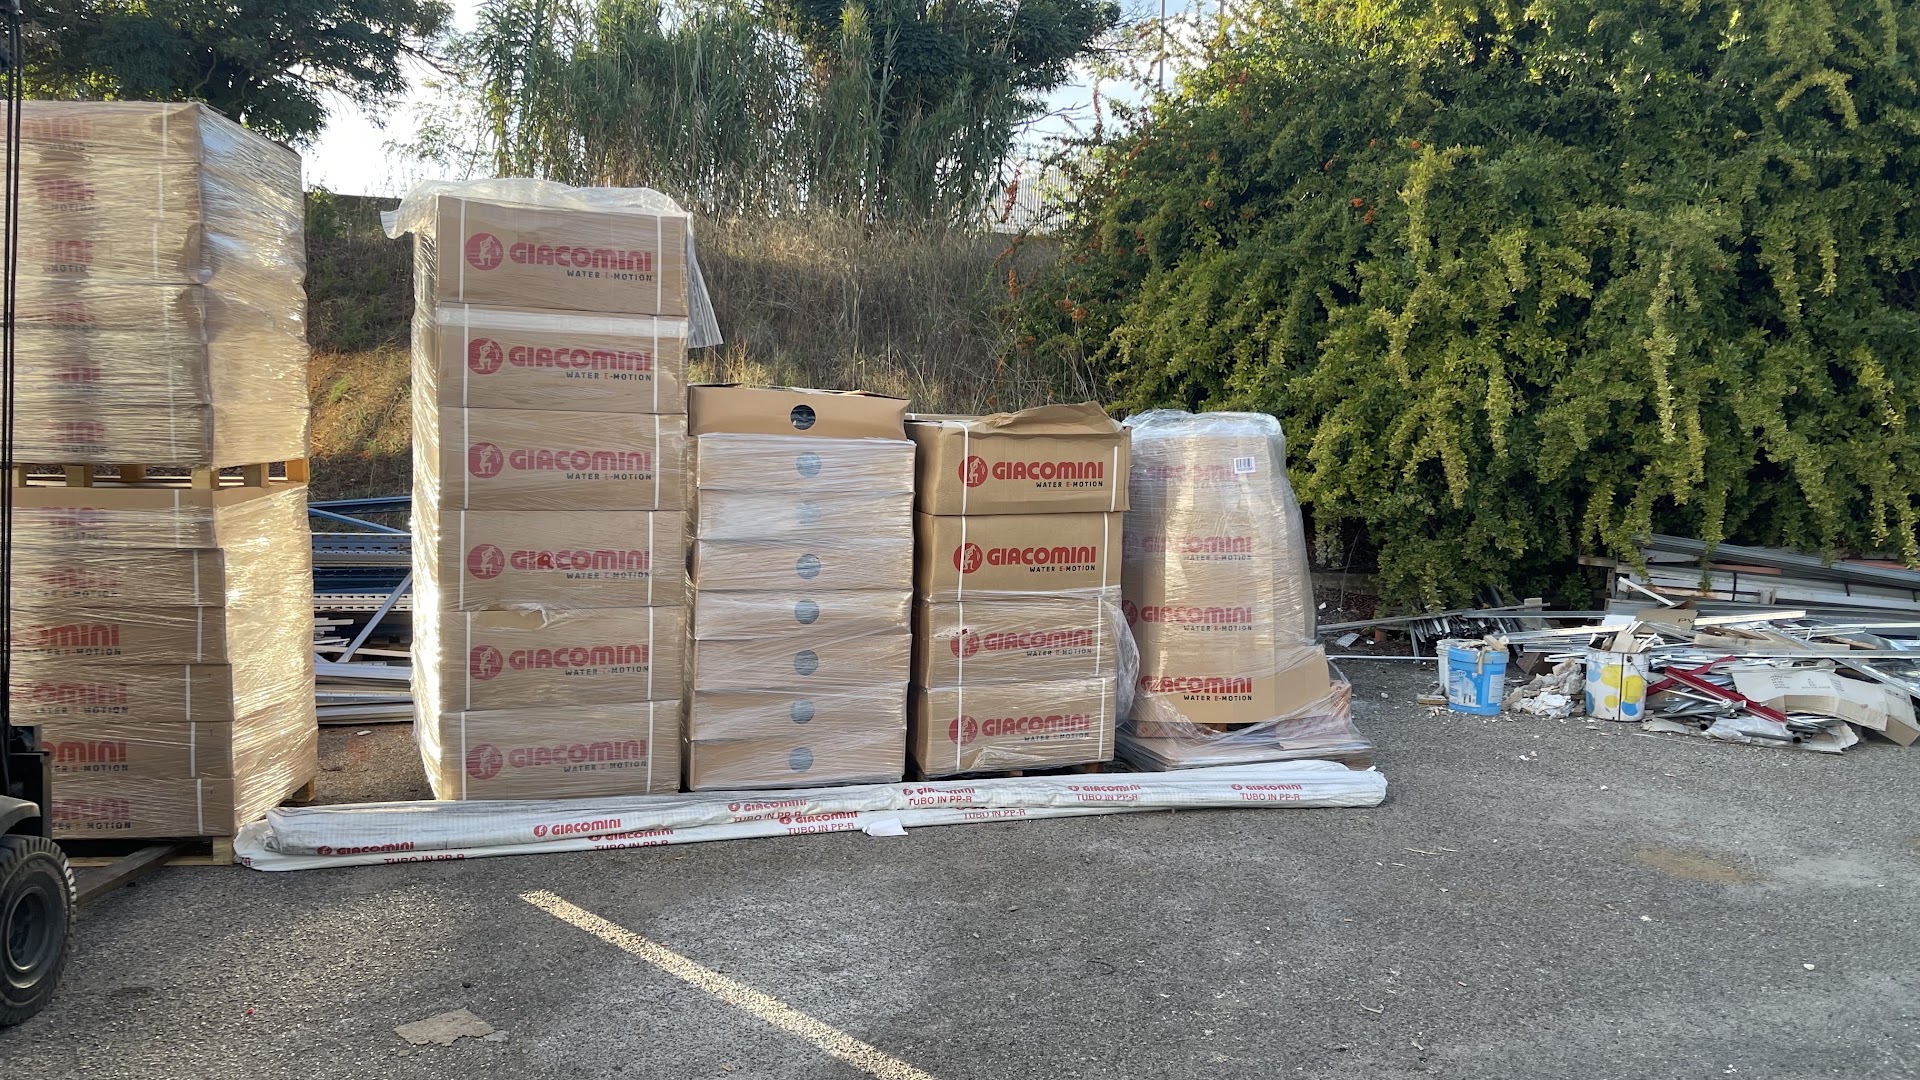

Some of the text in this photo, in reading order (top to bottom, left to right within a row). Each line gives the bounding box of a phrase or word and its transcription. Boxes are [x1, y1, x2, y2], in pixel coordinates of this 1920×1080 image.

[509, 242, 652, 272] GIACOMINI
[566, 269, 600, 279] WATER
[508, 346, 654, 372] GIACOMINI
[566, 371, 652, 381] WATER E-MOTION
[508, 449, 651, 471] GIACOMINI
[566, 472, 652, 481] WATER E-MOTION
[991, 461, 1104, 480] GIACOMINI
[510, 549, 650, 571] GIACOMINI
[986, 546, 1097, 566] GIACOMINI
[566, 572, 599, 580] WATER
[1141, 606, 1252, 624] GIACOMINI
[984, 629, 1093, 651] GIACOMINI
[508, 644, 649, 671] GIACOMINI
[565, 668, 598, 676] WATER
[1214, 694, 1252, 702] E-MOTION
[981, 713, 1091, 737] GIACOMINI
[507, 739, 647, 769] GIACOMINI
[563, 764, 597, 773] WATER
[1082, 784, 1141, 792] GIACOMINI
[909, 795, 972, 806] TUBO IN PP-R
[1076, 793, 1138, 801] TUBO IN PP-R
[1240, 792, 1300, 801] TUBO IN PP-R
[764, 812, 774, 820] IN
[795, 810, 858, 824] GIACOMINI
[551, 818, 622, 836] GIACOMINI
[787, 822, 855, 836] TUBO IN PP-R
[336, 841, 415, 855] GIACOMINI
